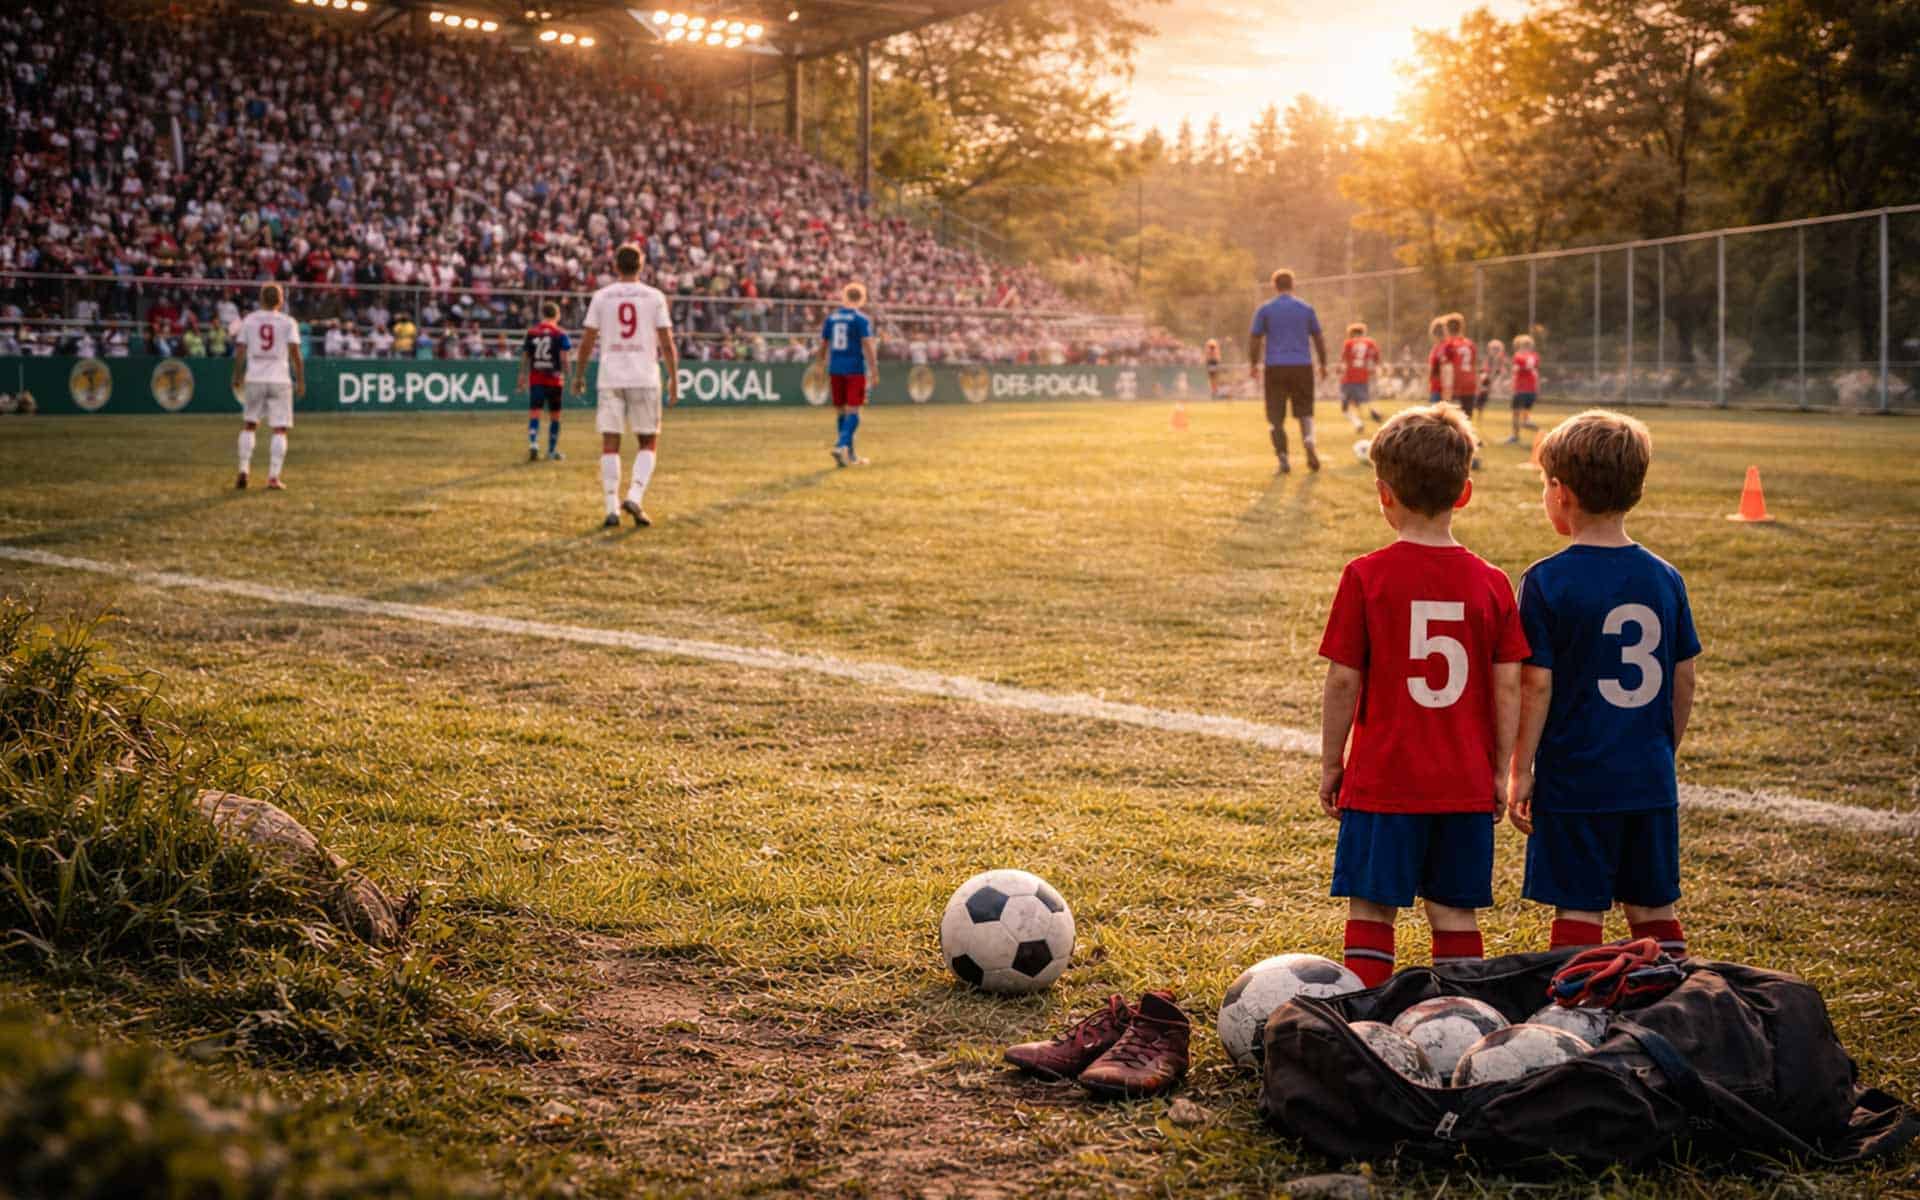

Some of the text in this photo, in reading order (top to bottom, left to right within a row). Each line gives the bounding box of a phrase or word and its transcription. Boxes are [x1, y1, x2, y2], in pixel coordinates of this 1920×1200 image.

[259, 323, 274, 351] 9
[618, 302, 637, 339] 9
[338, 372, 508, 403] DFB-POKAL
[677, 367, 781, 401] POKAL
[1407, 600, 1469, 709] 5
[1598, 603, 1663, 709] 3
